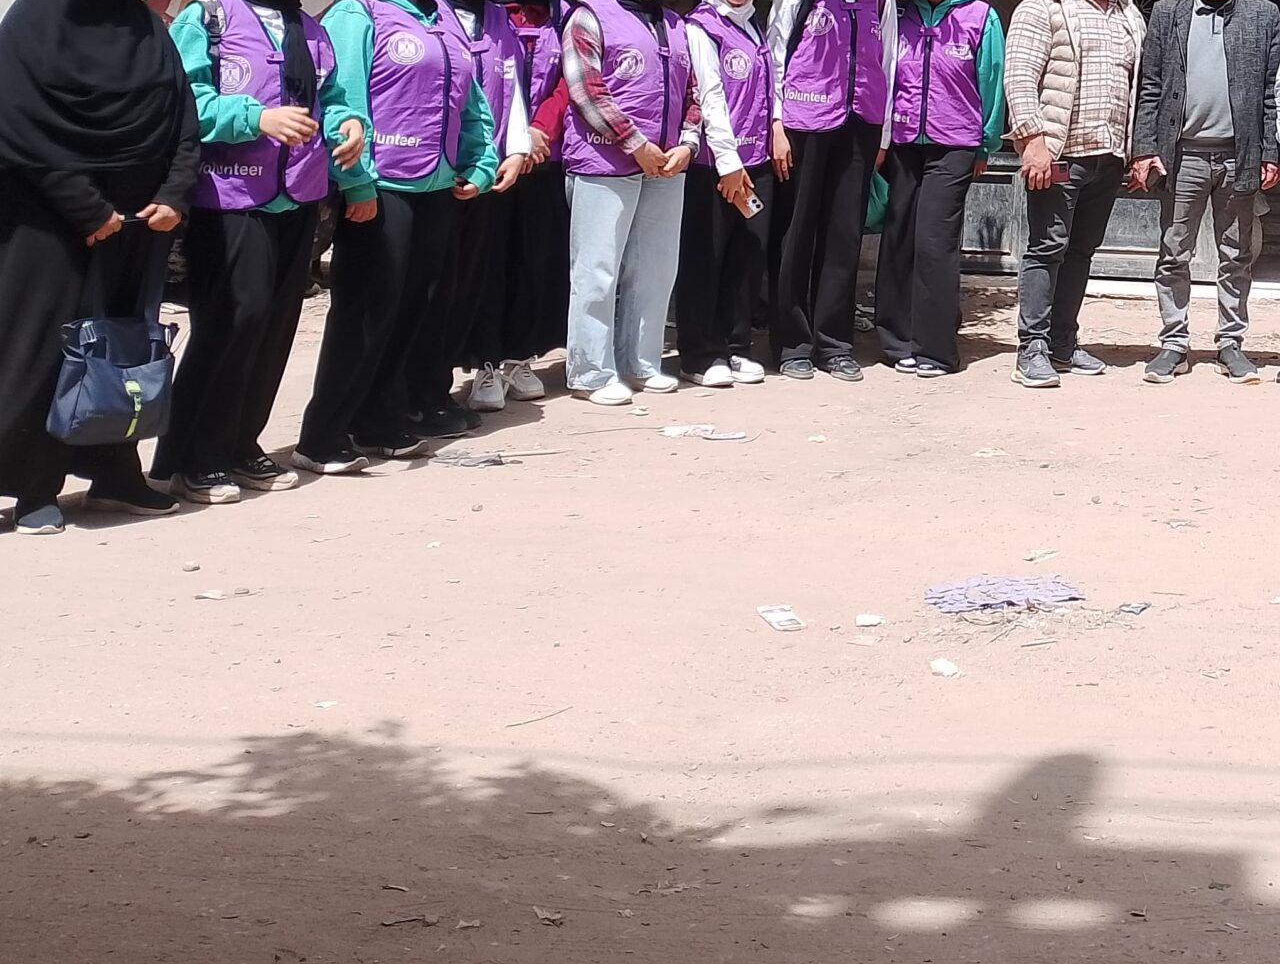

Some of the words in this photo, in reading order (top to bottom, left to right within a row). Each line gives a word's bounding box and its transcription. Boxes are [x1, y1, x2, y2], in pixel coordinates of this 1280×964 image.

[783, 87, 833, 104] Volunteer
[372, 129, 422, 148] lunteer
[735, 135, 758, 147] nteer
